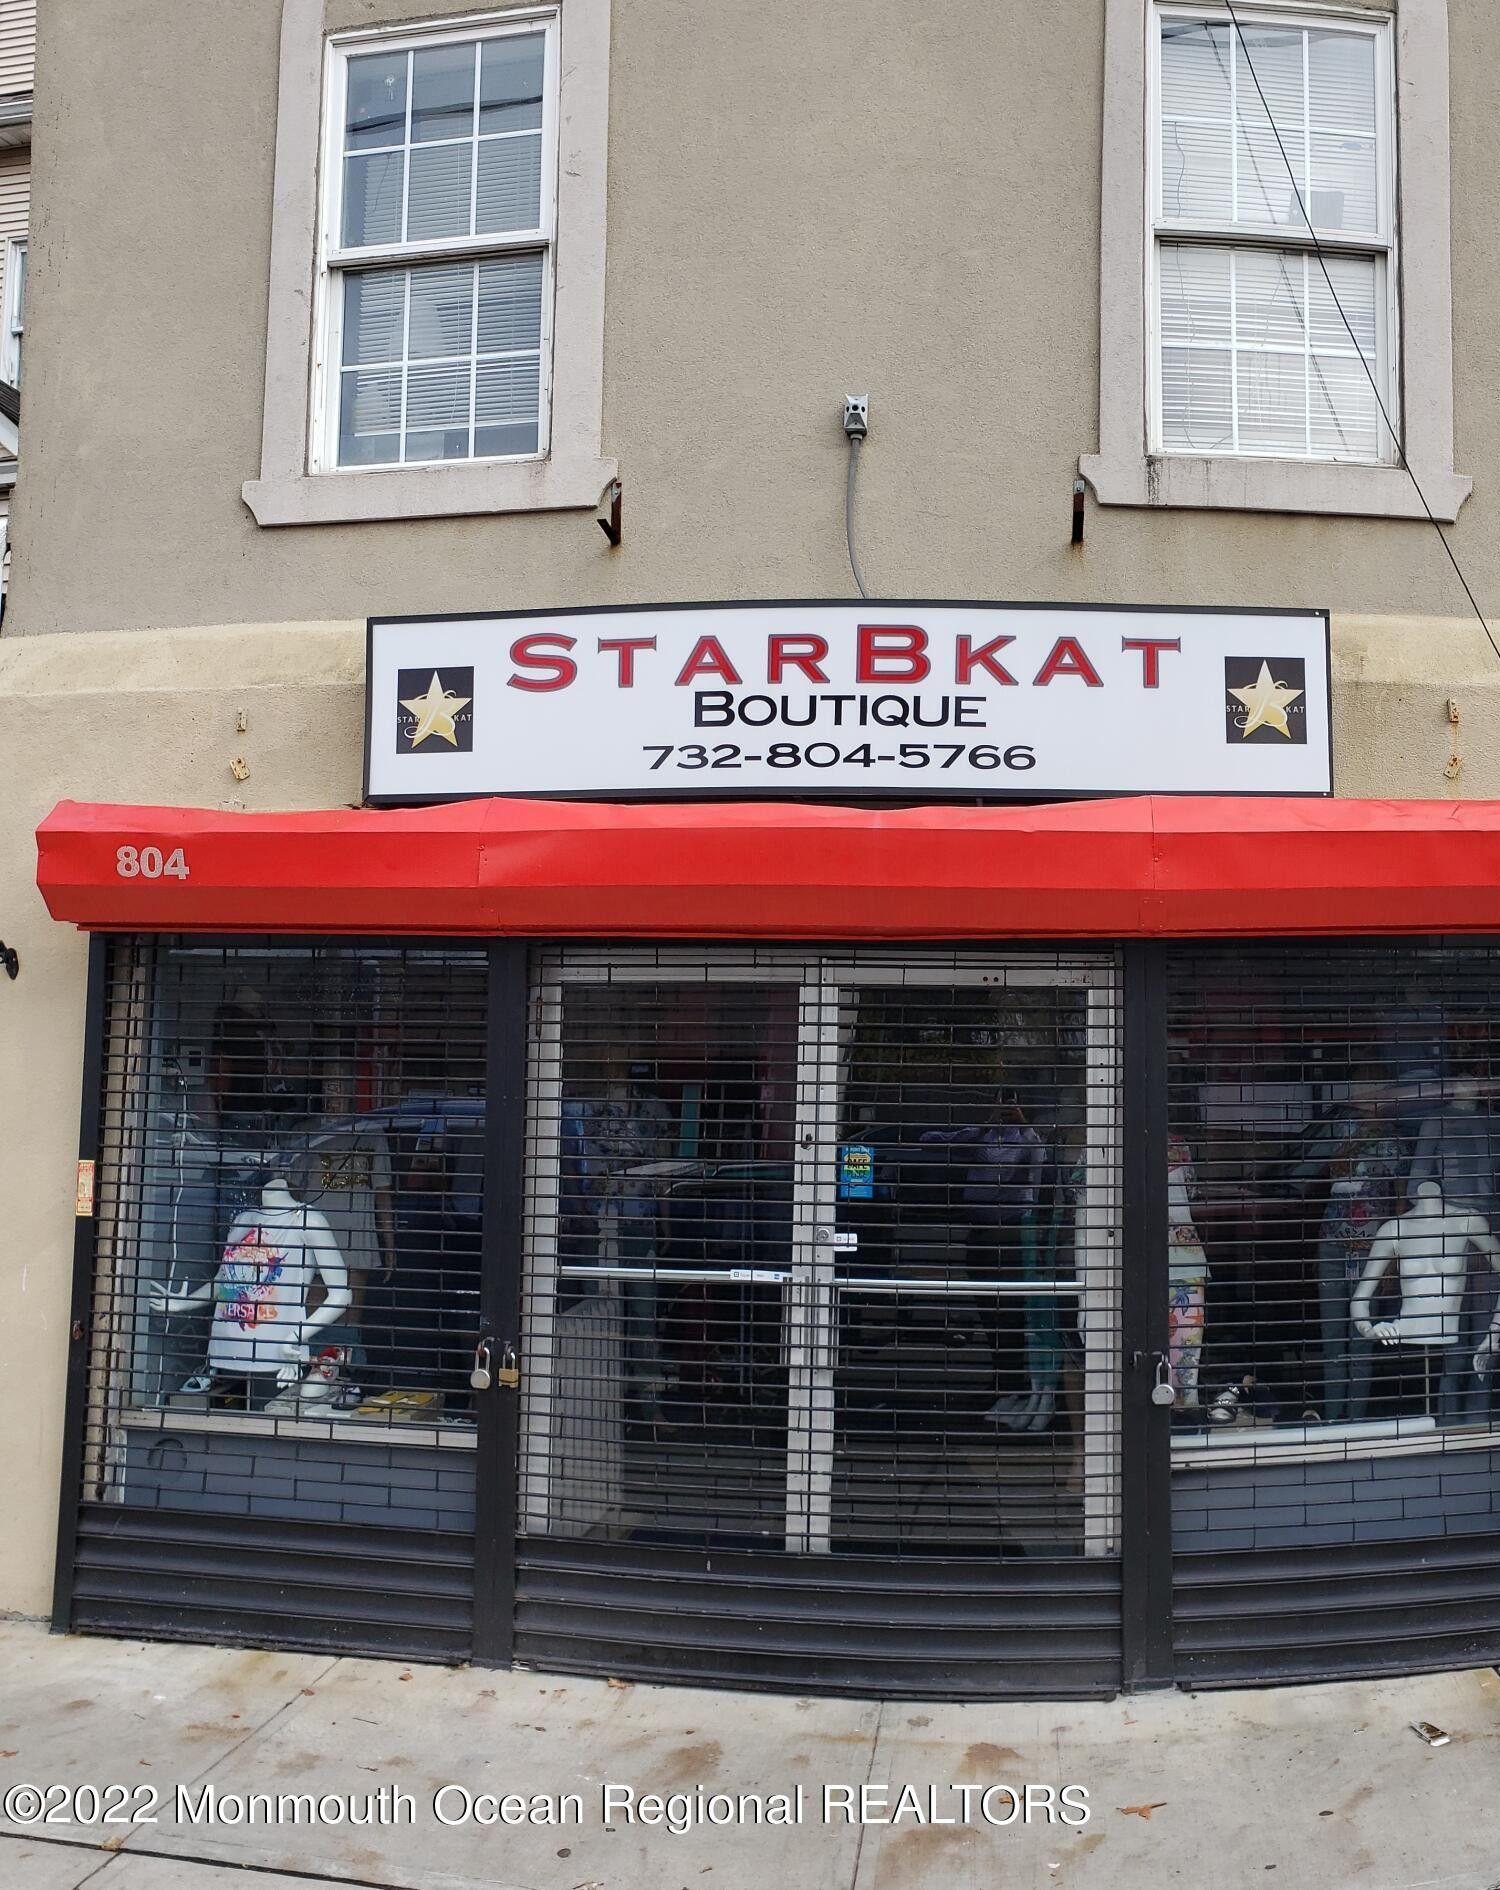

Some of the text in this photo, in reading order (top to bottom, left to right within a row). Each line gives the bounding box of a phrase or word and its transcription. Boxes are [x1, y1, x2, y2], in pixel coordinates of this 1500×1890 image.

[693, 691, 988, 729] BOUTIQUE
[641, 742, 1037, 771] 732-804-5766
[116, 845, 190, 880] 804
